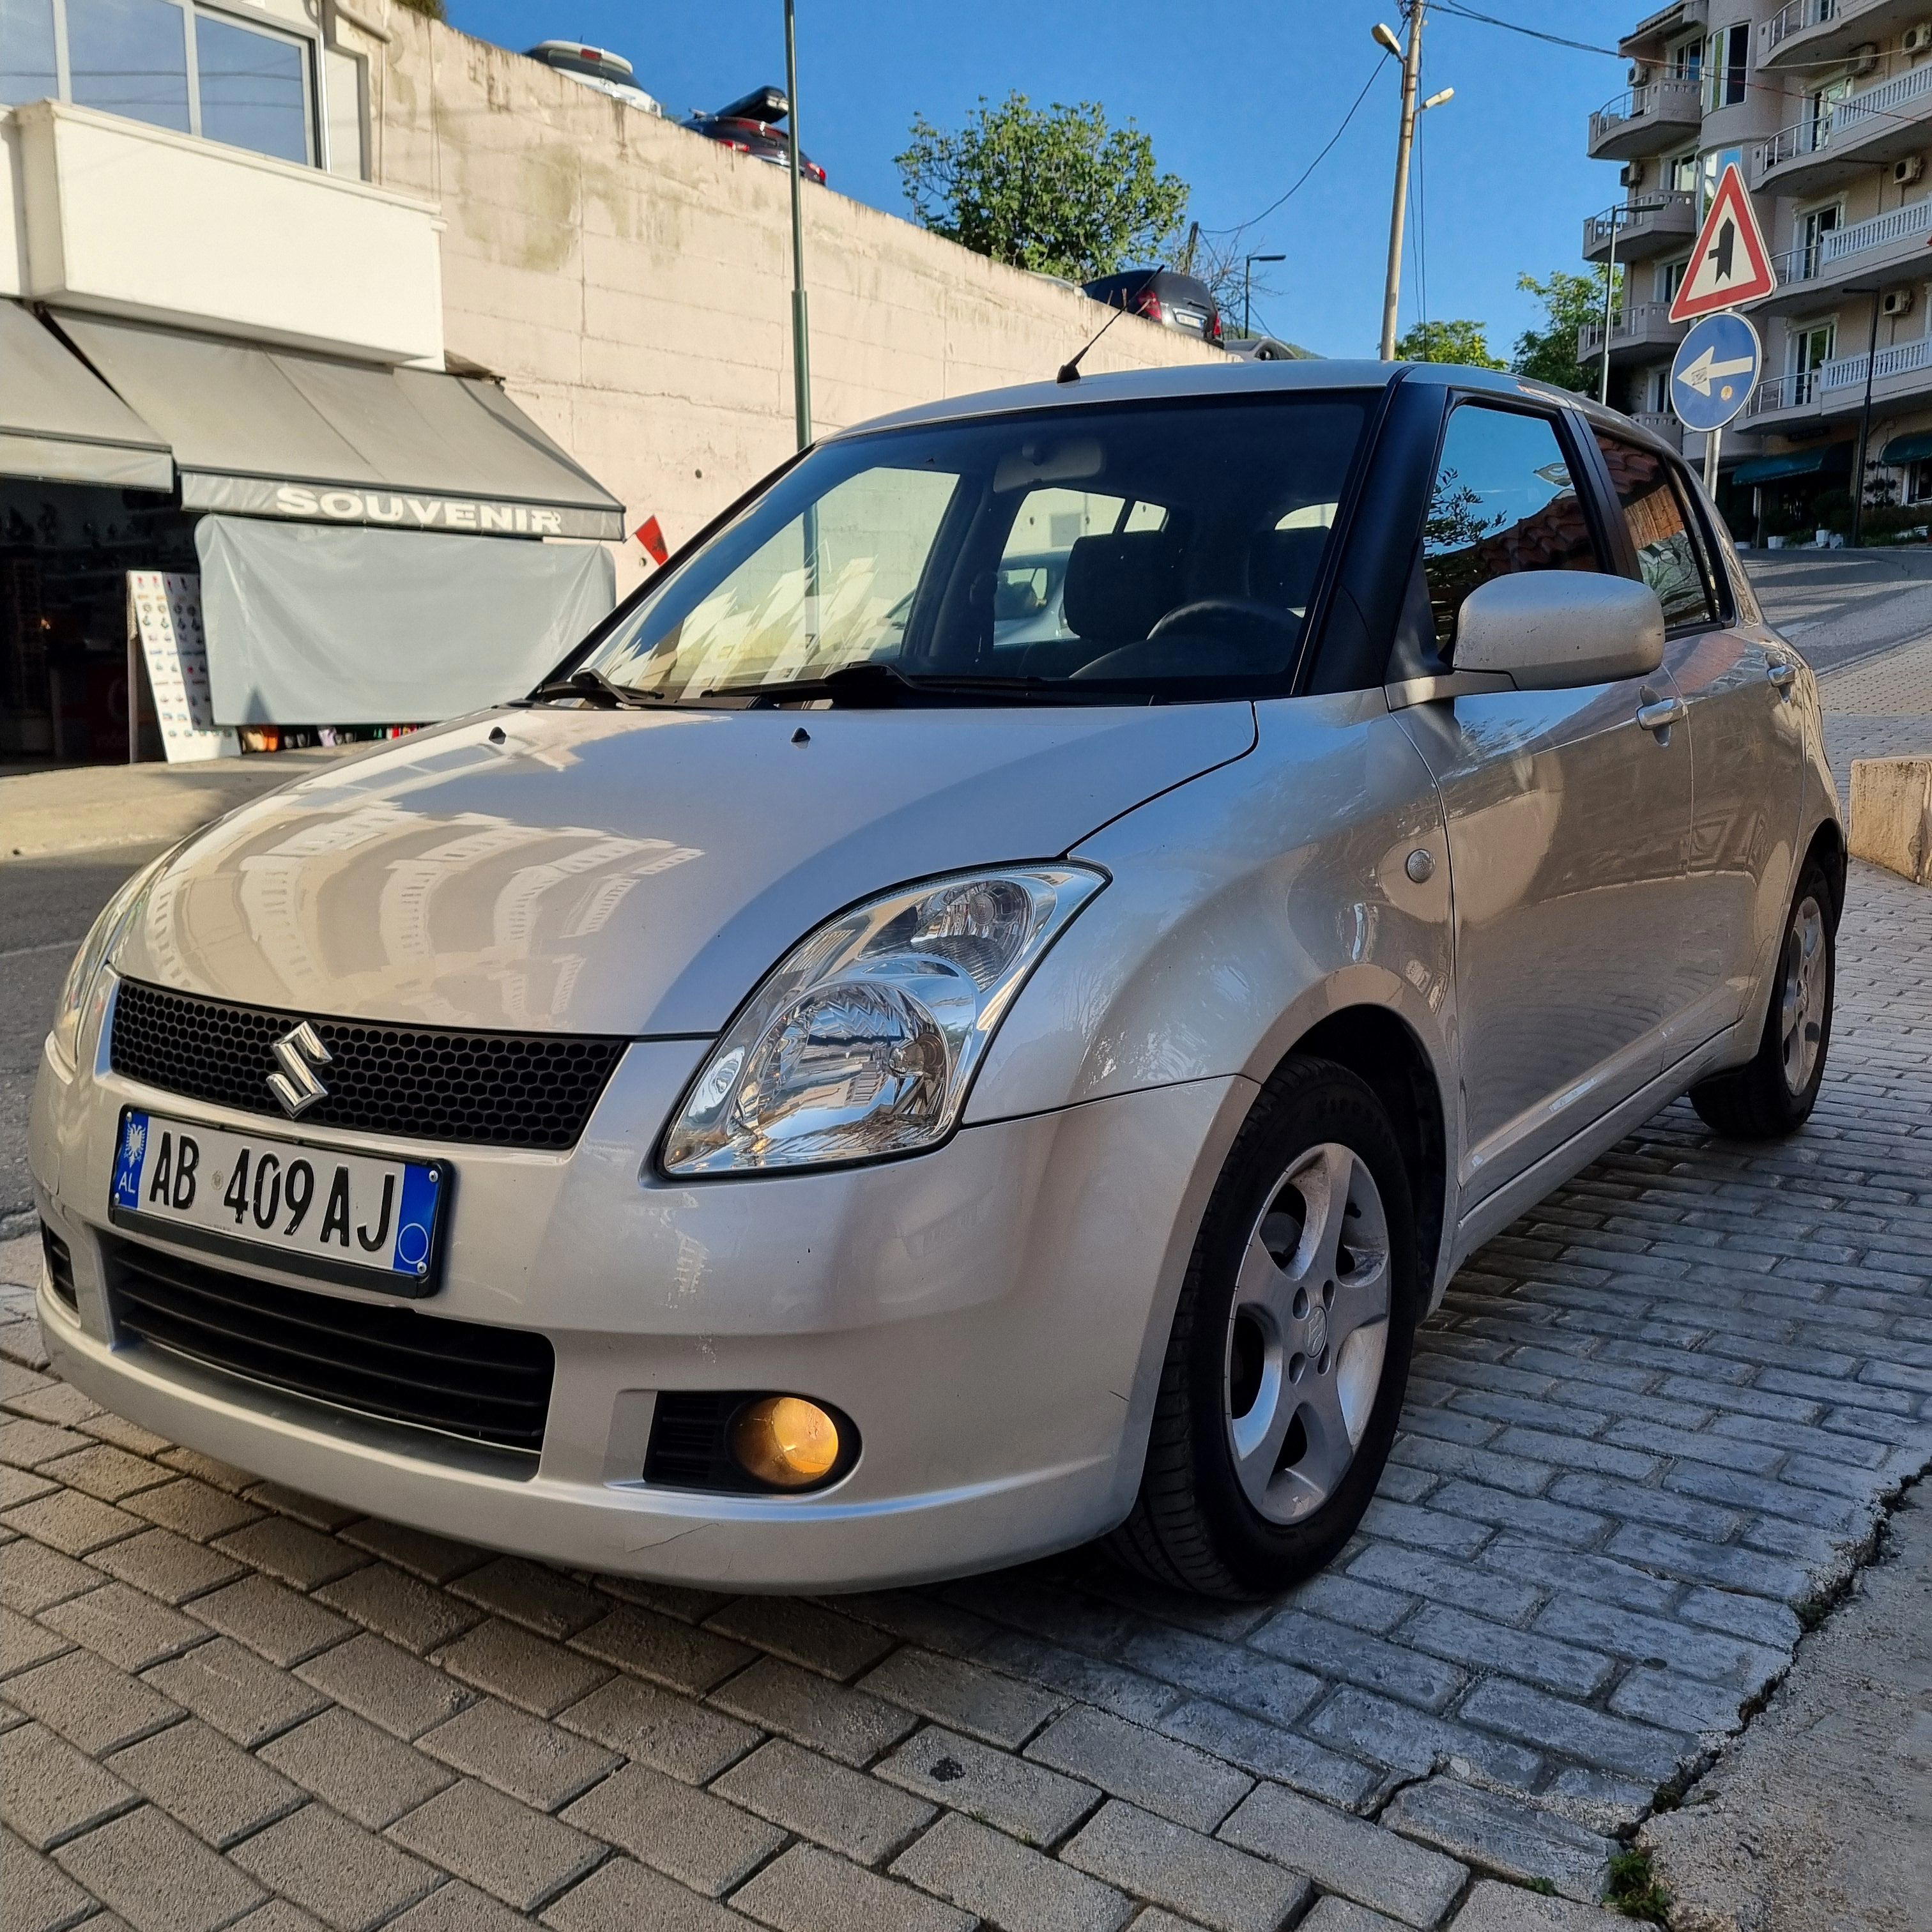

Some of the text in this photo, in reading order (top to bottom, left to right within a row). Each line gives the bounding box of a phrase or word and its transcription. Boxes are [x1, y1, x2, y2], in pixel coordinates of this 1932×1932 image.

[276, 486, 562, 534] SOUVENIR
[118, 1171, 137, 1193] AL
[149, 1131, 395, 1252] AB 409 AJ
